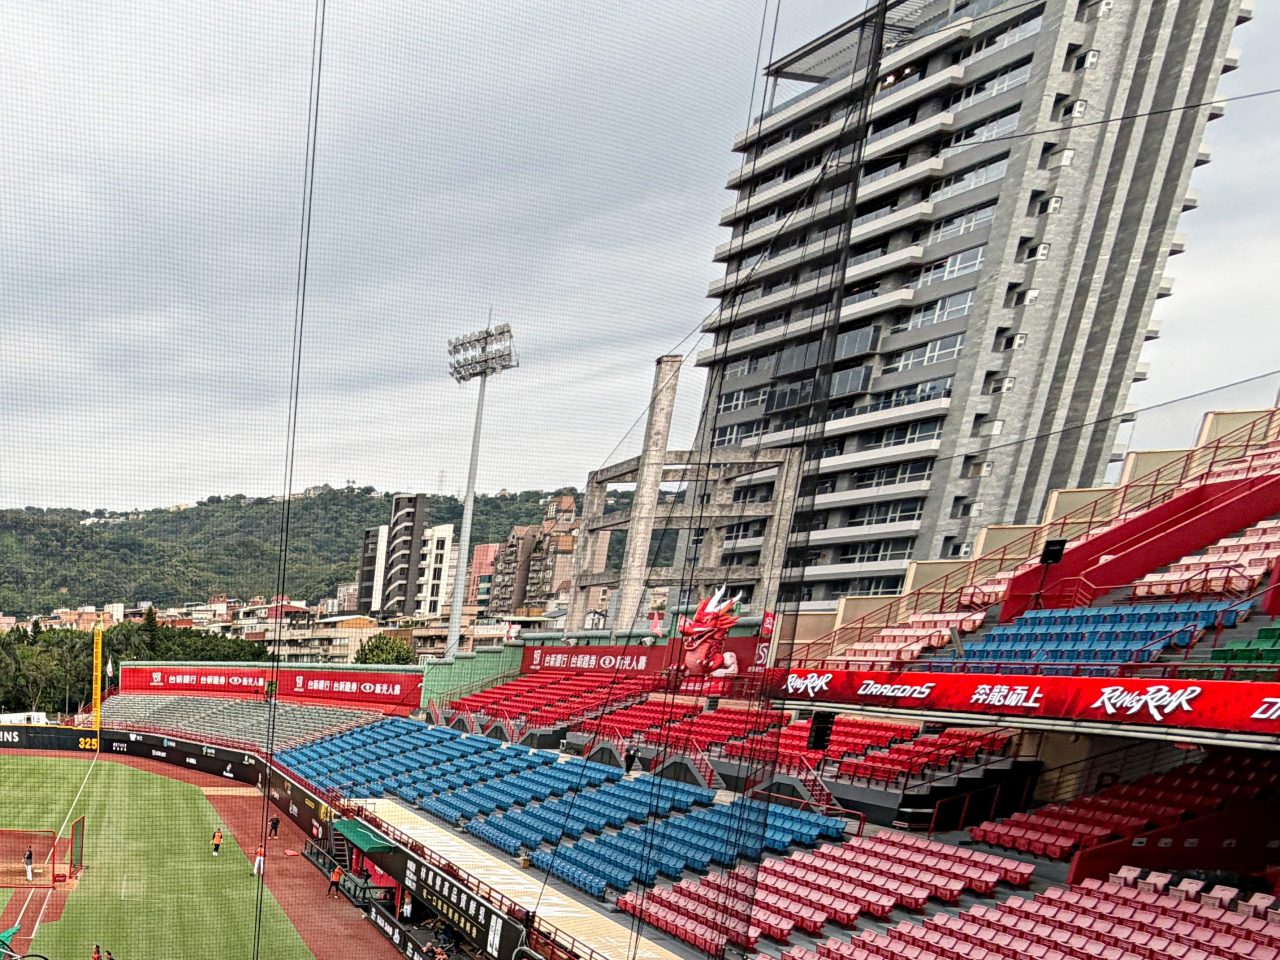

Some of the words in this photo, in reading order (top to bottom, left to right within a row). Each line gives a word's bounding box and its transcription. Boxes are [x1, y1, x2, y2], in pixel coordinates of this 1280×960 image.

[857, 680, 937, 699] DRAGONS
[1090, 685, 1202, 721] RUN&ROAR
[79, 738, 98, 750] 325
